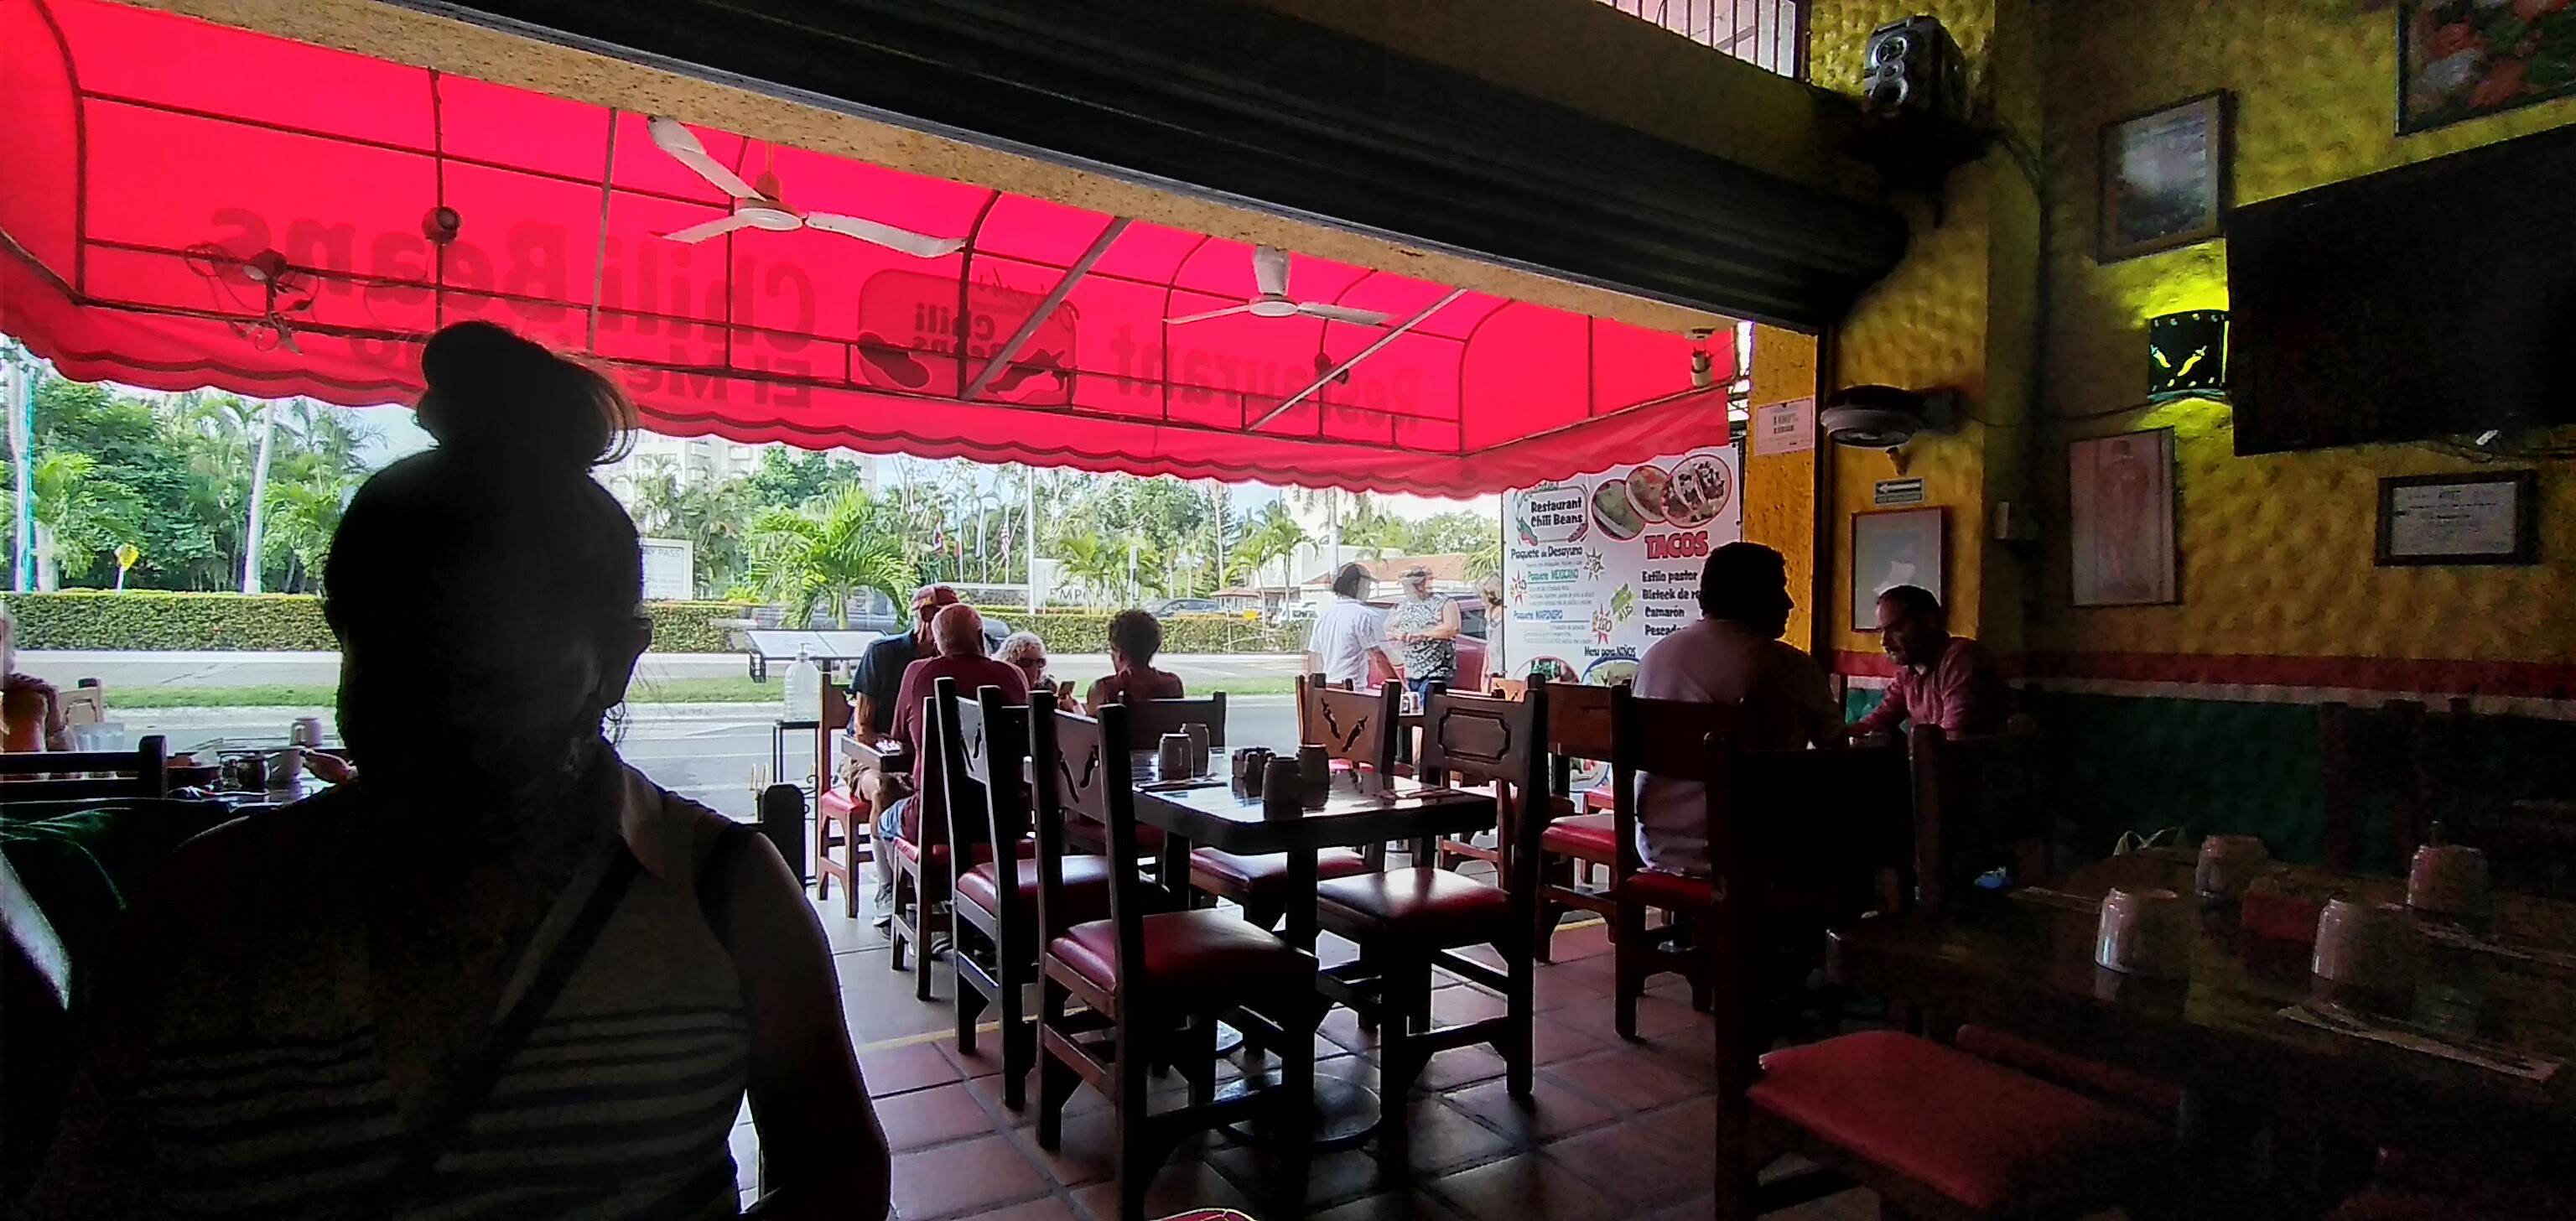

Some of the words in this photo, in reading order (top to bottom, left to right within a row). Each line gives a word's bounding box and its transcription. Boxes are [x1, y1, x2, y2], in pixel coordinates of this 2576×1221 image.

[1530, 496, 1582, 513] Restaurant
[1530, 514, 1551, 527] Chili
[1553, 514, 1583, 526] Beans
[1644, 530, 1709, 559] TACOS
[1642, 570, 1667, 582] Estilo
[1668, 570, 1698, 584] pastor
[1678, 587, 1690, 600] de
[1644, 624, 1680, 636] Pescad
